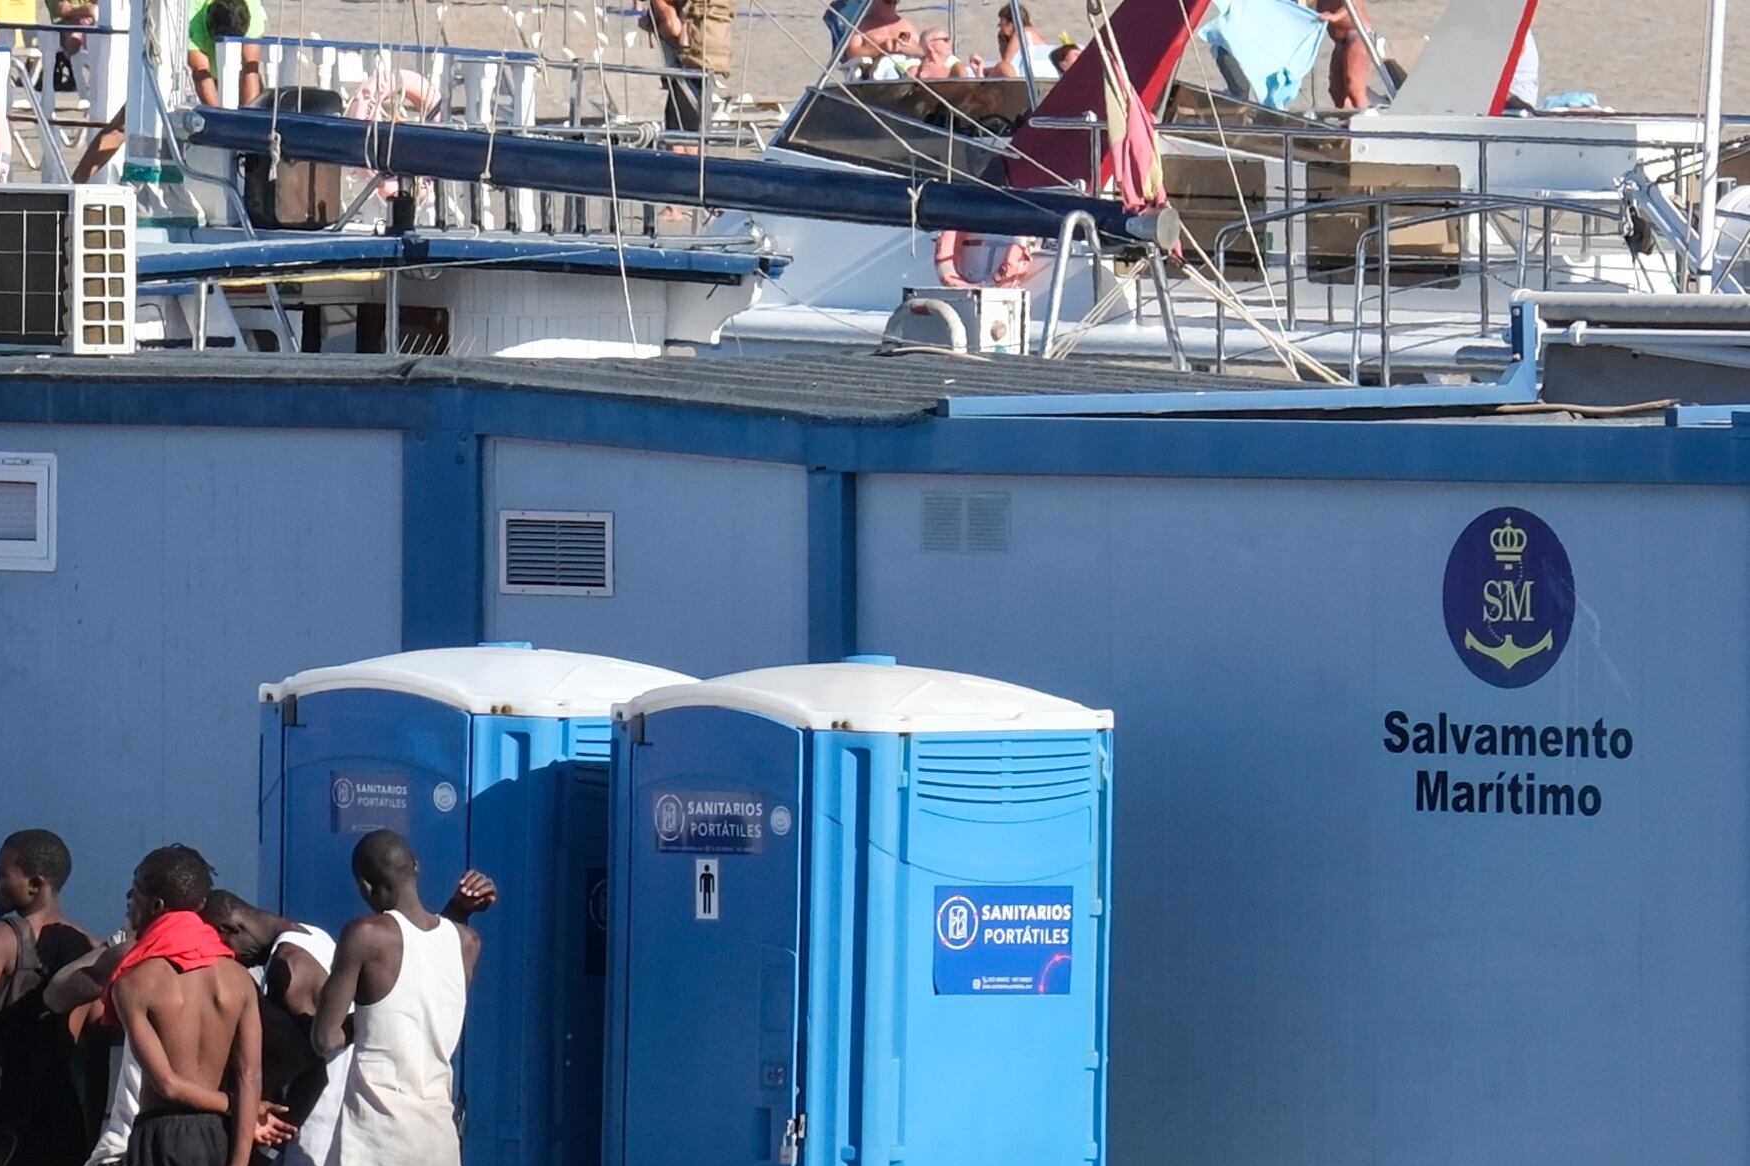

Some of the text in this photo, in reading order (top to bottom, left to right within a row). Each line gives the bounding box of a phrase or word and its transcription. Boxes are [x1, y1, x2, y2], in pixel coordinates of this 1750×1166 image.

[1482, 580, 1535, 622] SM
[1383, 710, 1633, 759] Salvamento
[355, 783, 408, 795] SANITARIOS
[1415, 770, 1602, 816] Marítimo
[687, 800, 763, 817] SANITARIOS
[690, 821, 762, 839] PORTÁTILES
[981, 904, 1072, 921] SANITARIOS
[983, 925, 1069, 945] PORTÁTILES
